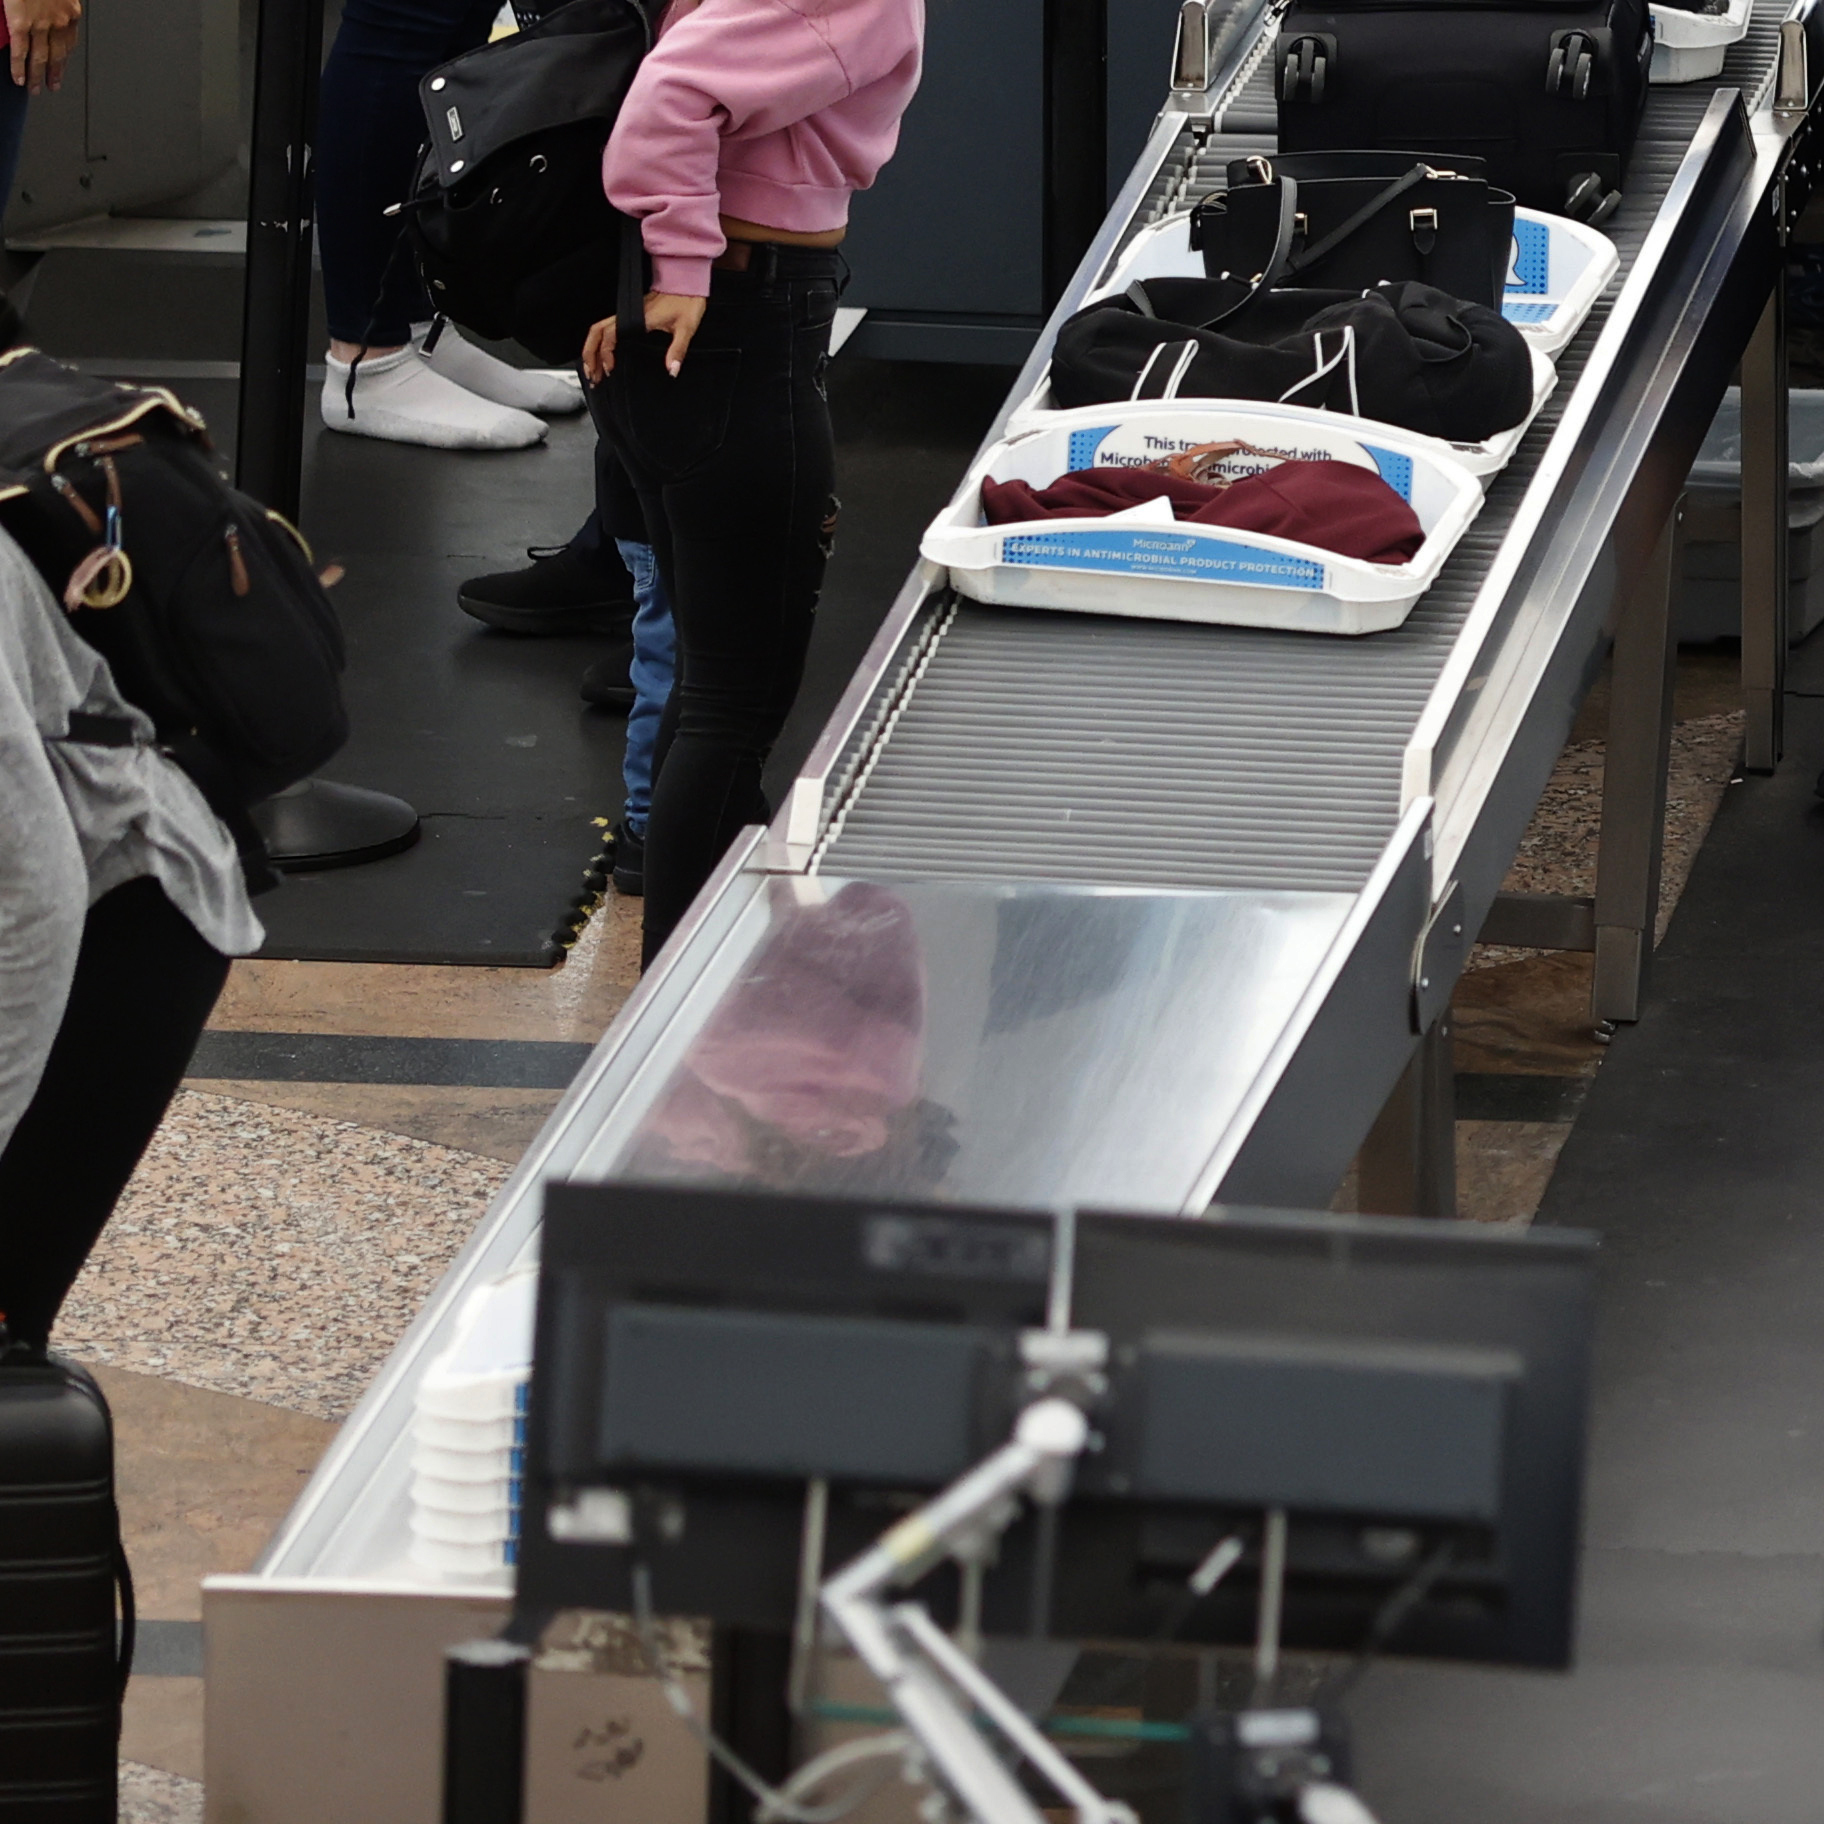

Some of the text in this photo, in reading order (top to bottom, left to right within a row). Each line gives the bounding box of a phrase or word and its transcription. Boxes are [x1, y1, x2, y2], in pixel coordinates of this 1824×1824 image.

[1144, 436, 1175, 451] This
[1301, 449, 1332, 462] with
[1010, 543, 1316, 577] EXPERTS IN ANTIMICROBIAL PRODUCT PROTECTION
